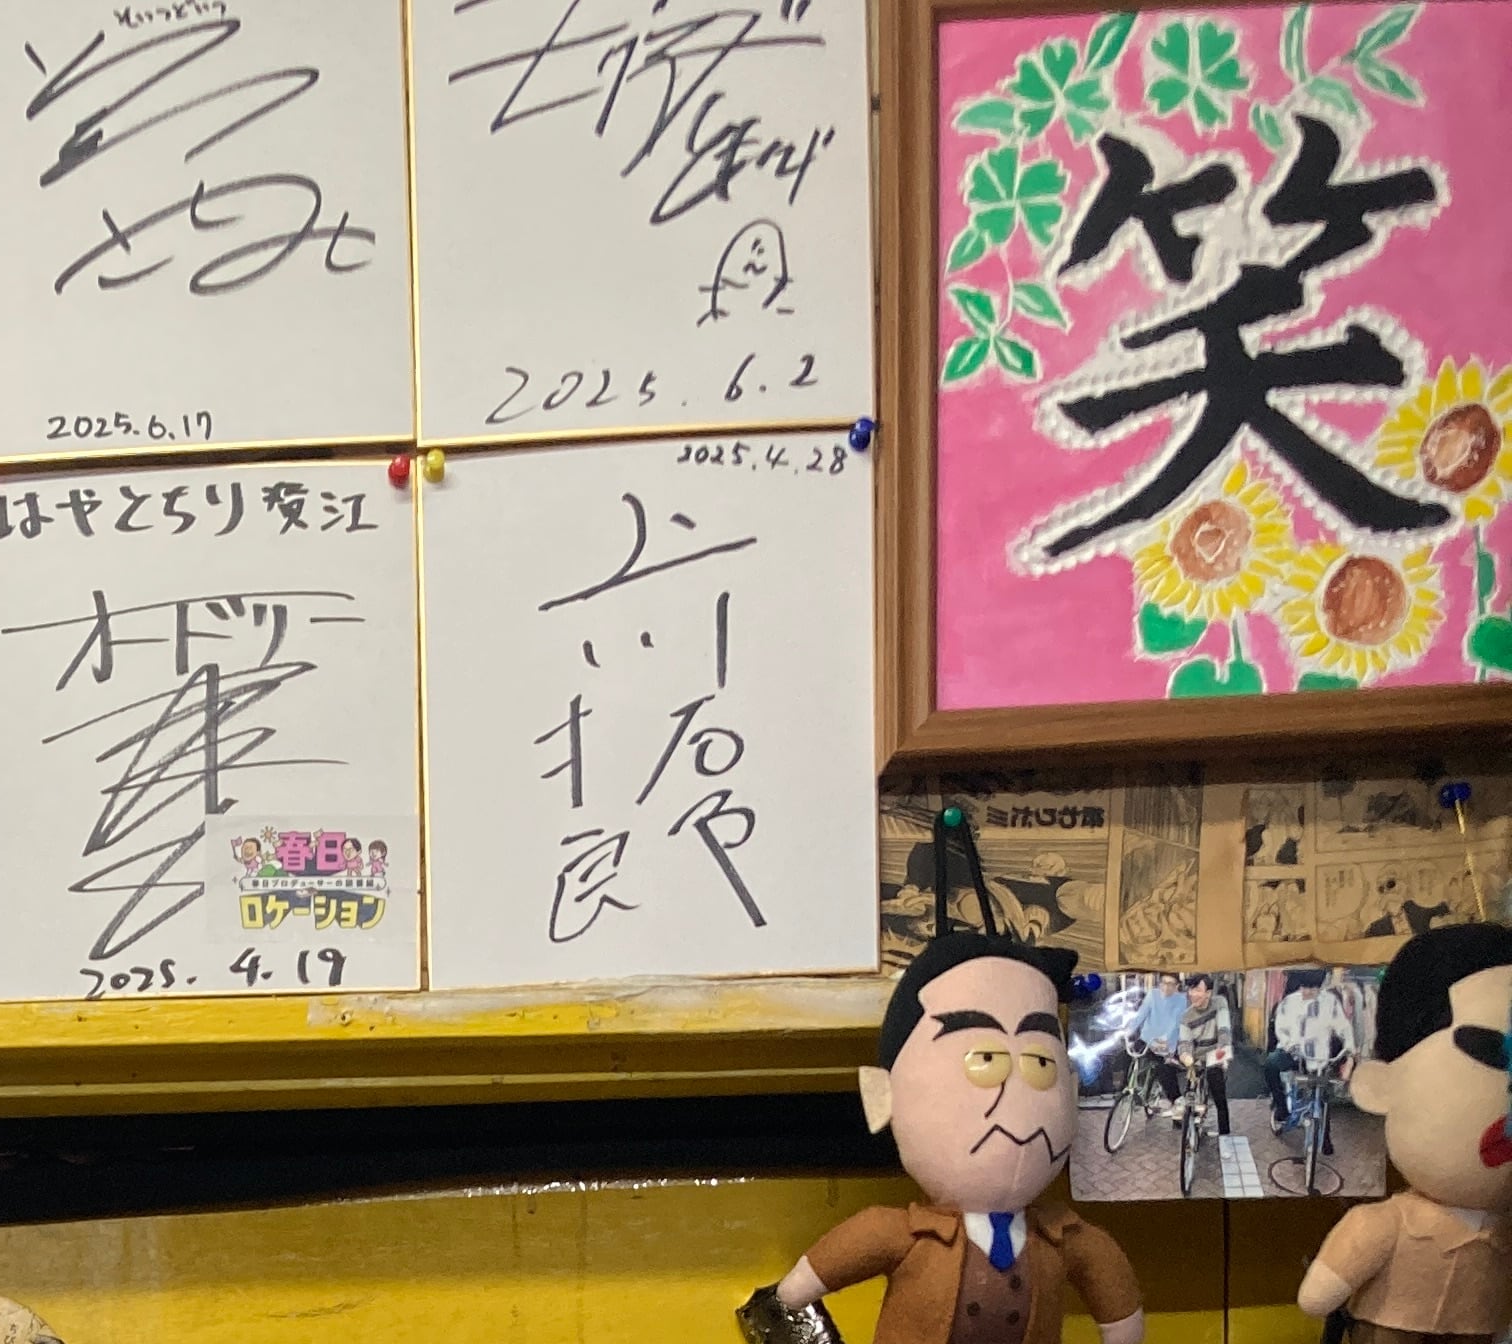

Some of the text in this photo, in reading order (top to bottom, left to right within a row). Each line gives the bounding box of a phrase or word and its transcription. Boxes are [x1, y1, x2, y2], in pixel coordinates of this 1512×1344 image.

[1042, 112, 1452, 558] 笑
[46, 411, 213, 440] 2025.6.17
[677, 442, 848, 475] 2025.4.28
[275, 831, 347, 871] 春日
[239, 895, 386, 930] ロケーション
